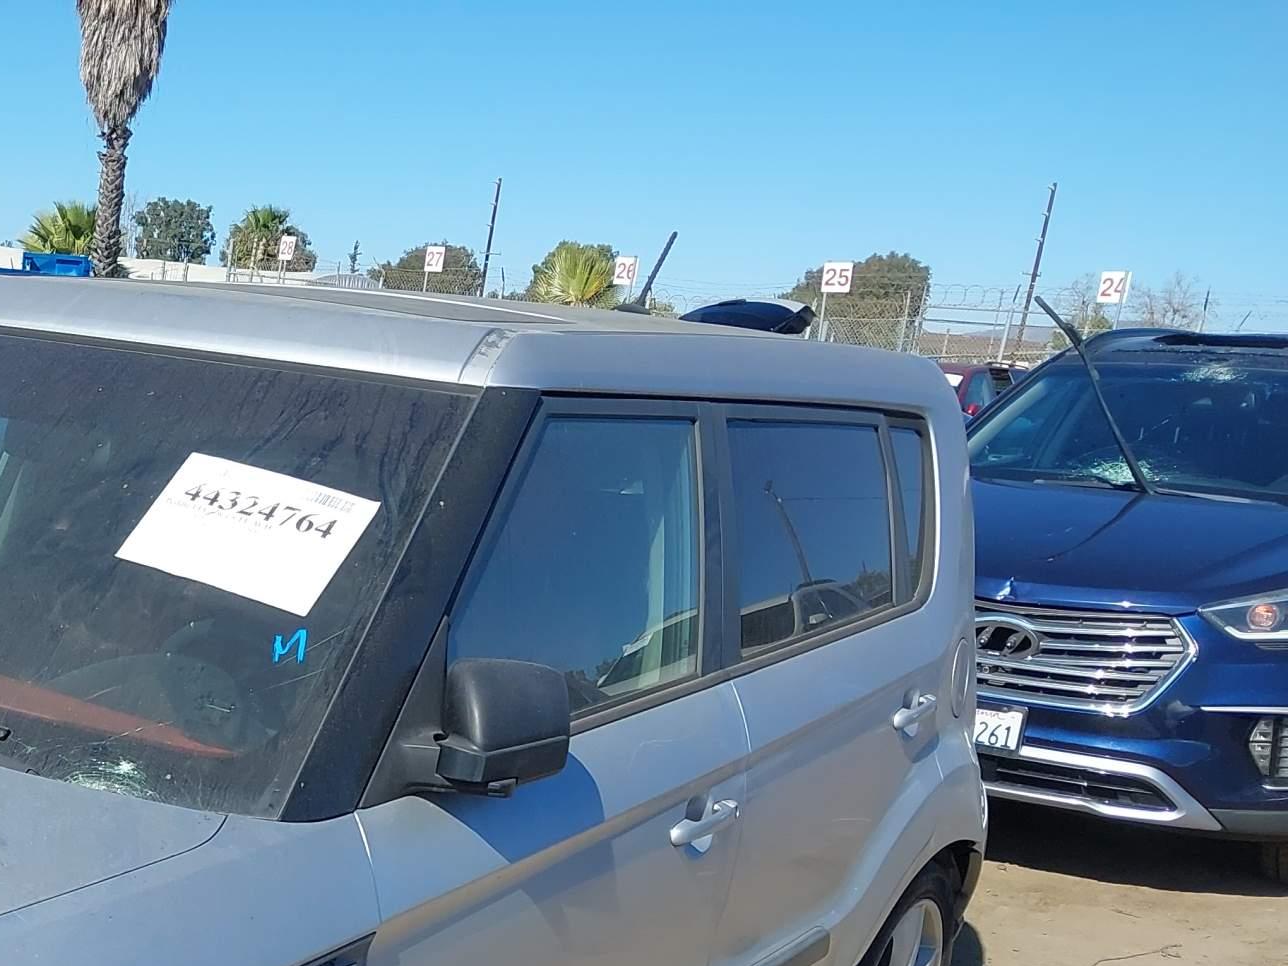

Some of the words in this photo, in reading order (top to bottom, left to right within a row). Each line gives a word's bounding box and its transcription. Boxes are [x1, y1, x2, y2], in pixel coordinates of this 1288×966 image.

[281, 240, 294, 255] 28
[426, 251, 443, 267] 27
[824, 268, 850, 286] 25
[184, 483, 338, 539] 44324764
